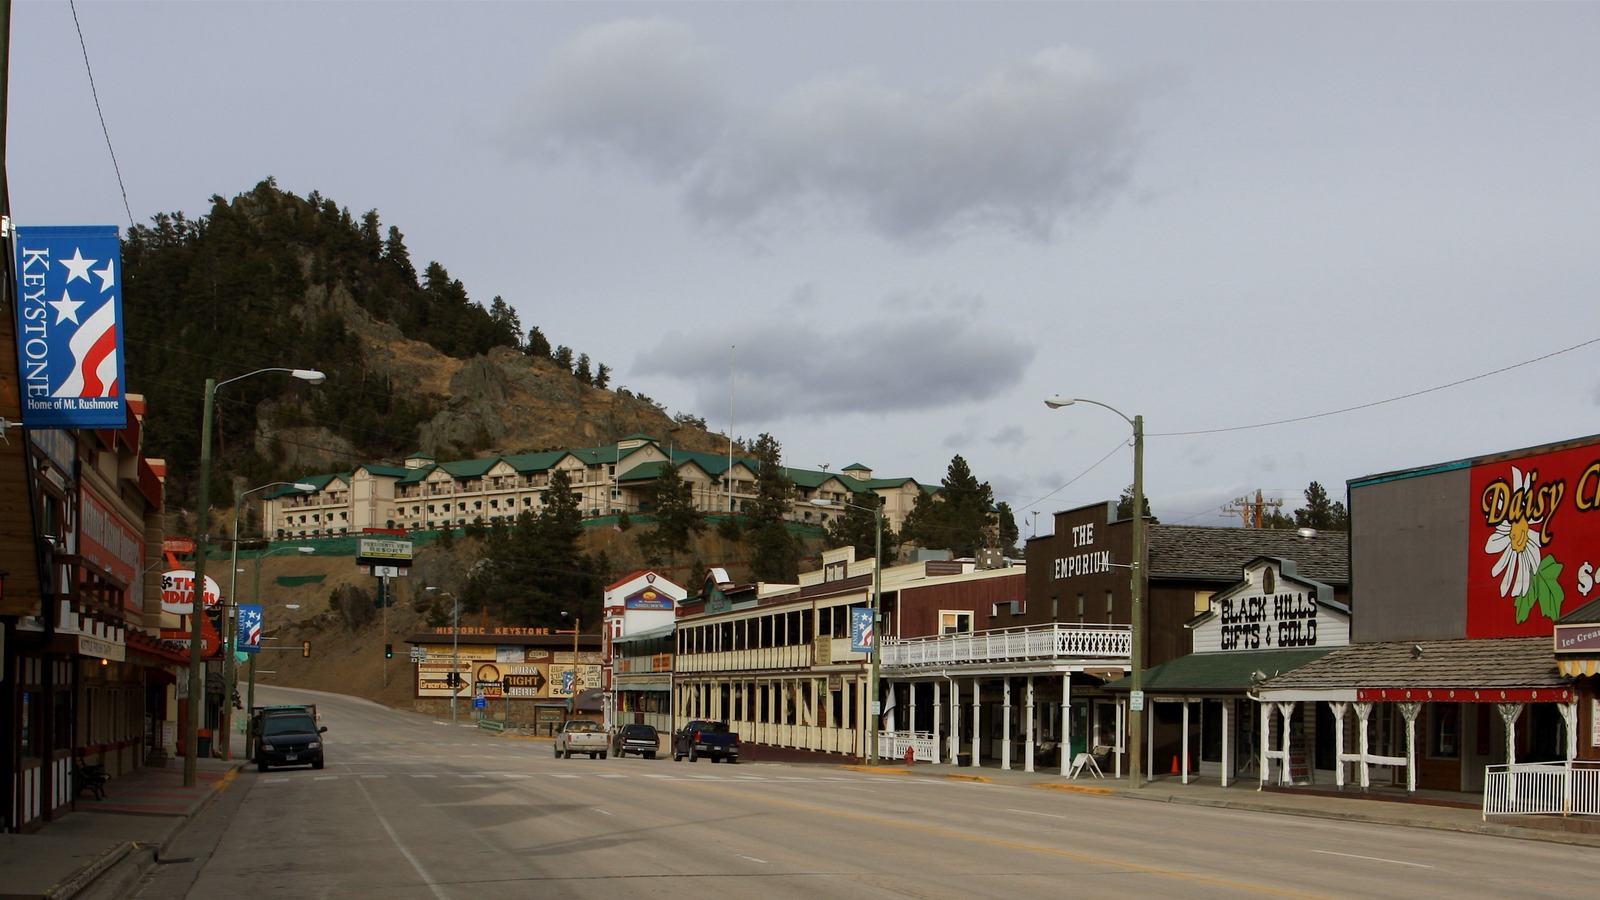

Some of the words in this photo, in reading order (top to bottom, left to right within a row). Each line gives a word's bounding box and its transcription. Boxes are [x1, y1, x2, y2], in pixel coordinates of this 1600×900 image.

[22, 246, 50, 398] KEYSTONE
[27, 399, 52, 410] Home
[54, 399, 62, 410] of
[63, 399, 77, 410] Mt.
[78, 398, 119, 410] Rushmore
[1482, 469, 1565, 546] Daisy
[1072, 523, 1094, 548] THE
[1054, 550, 1110, 580] EMPORIUM
[1221, 597, 1267, 624] BLACK
[1274, 591, 1318, 620] HILLS
[494, 627, 549, 635] KEYSTONE
[1221, 624, 1260, 650] GIFTS
[1266, 625, 1272, 646] &
[1278, 619, 1317, 647] GOLD
[1561, 638, 1575, 648] Ice
[1577, 631, 1600, 643] Crea
[510, 666, 538, 674] TURN
[482, 686, 501, 694] AVE
[507, 687, 536, 696] HERE
